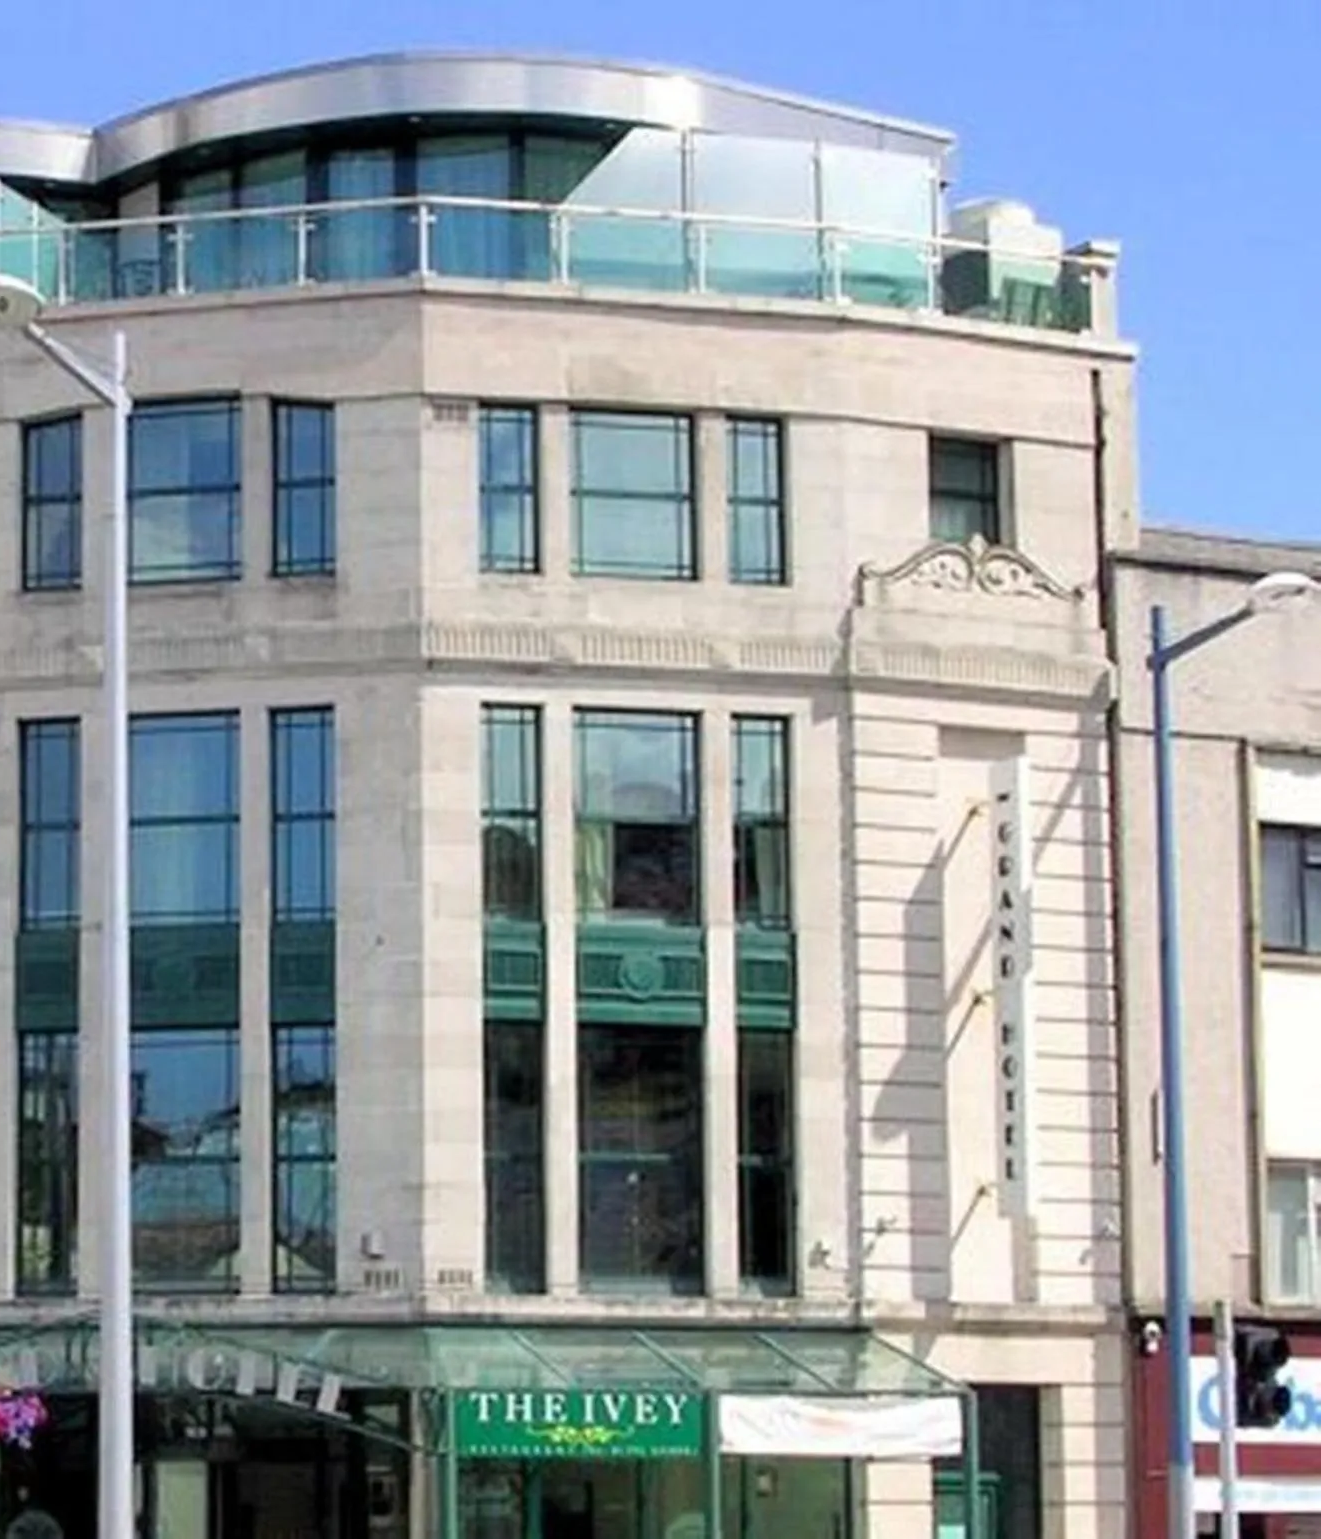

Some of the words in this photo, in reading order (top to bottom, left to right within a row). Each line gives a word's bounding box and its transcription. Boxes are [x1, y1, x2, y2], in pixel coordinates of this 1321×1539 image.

[997, 819, 1014, 978] GRAND
[1001, 1022, 1018, 1181] HOTEL
[469, 1393, 568, 1423] THE
[583, 1393, 688, 1424] IVEY
